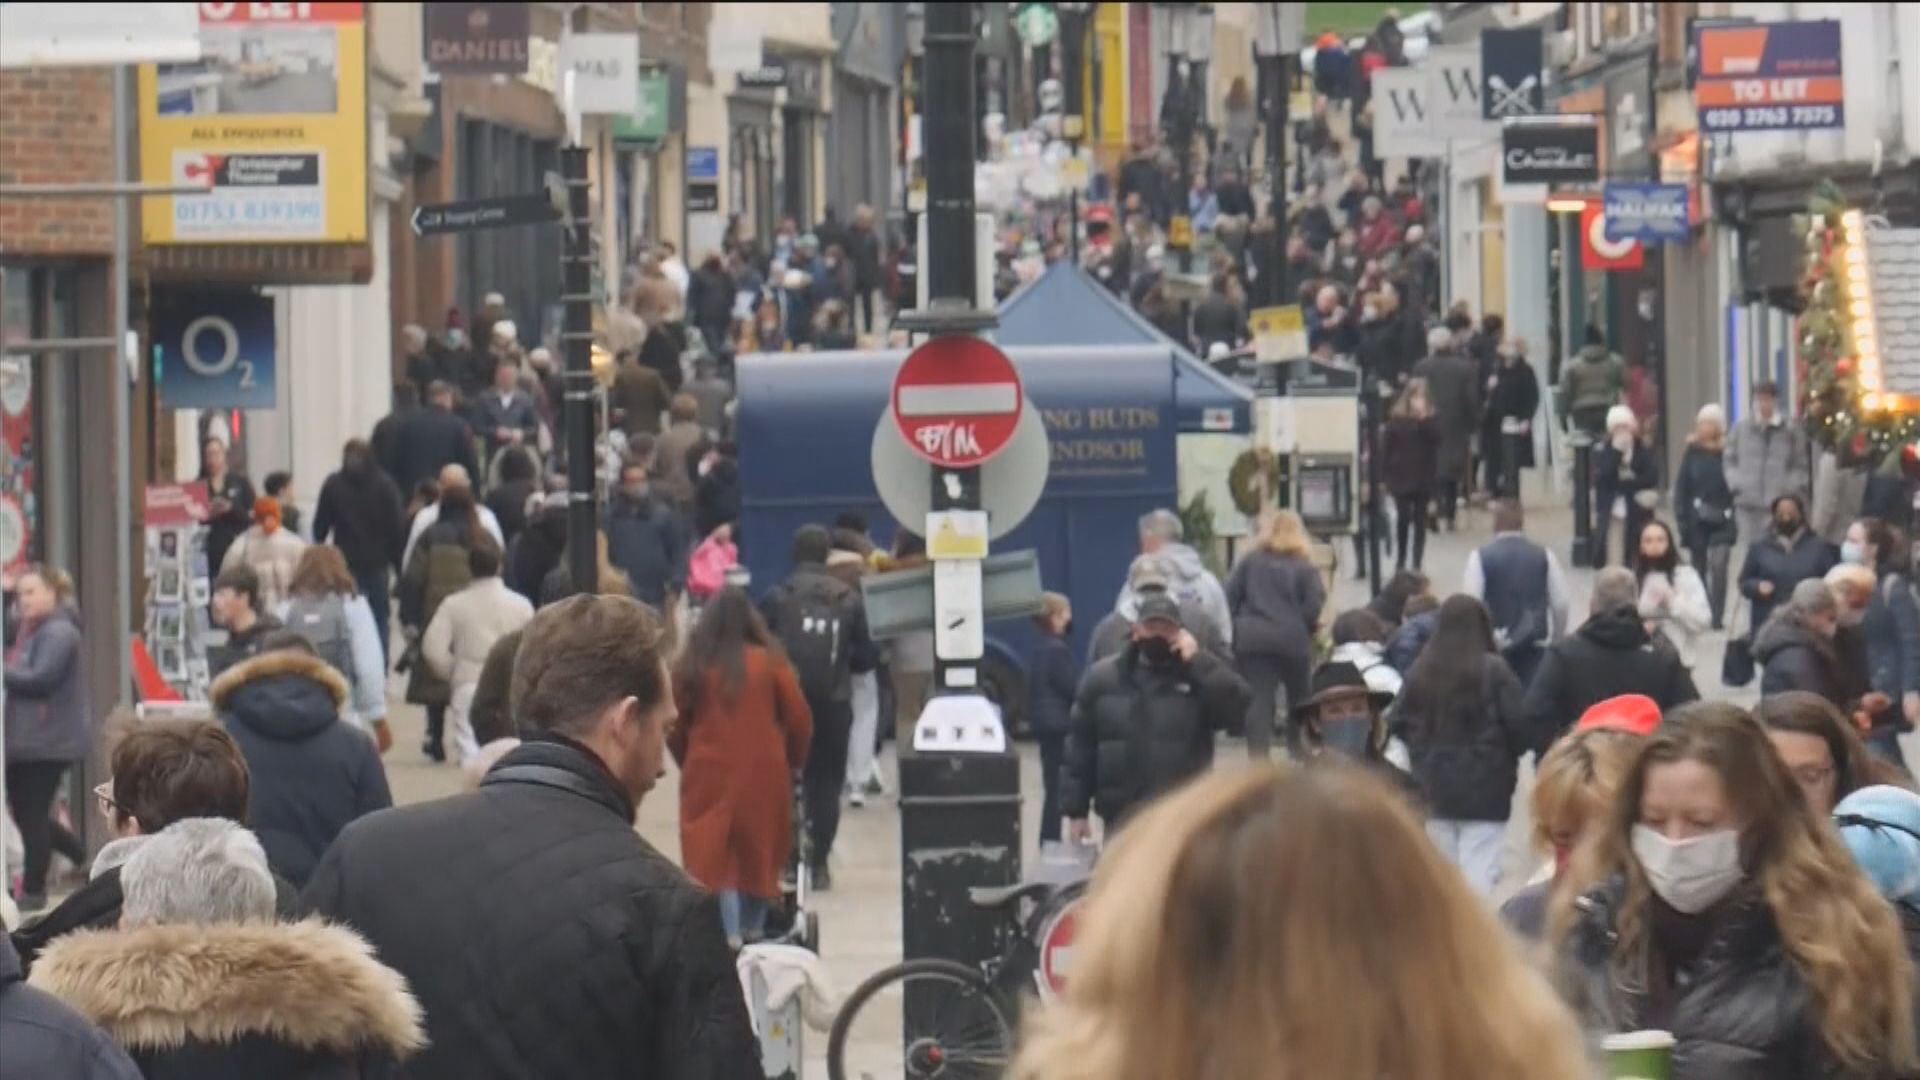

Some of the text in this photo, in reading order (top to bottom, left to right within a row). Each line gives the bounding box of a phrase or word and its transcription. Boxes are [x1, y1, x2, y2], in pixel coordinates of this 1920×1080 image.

[431, 39, 528, 62] DANIEL
[574, 59, 620, 78] M&S
[1731, 78, 1808, 102] TO LET
[1388, 88, 1424, 122] W
[192, 128, 216, 138] ALL
[1606, 203, 1685, 219] HALIFAX
[1089, 408, 1158, 429] BUDS
[1050, 440, 1144, 460] INDSOR
